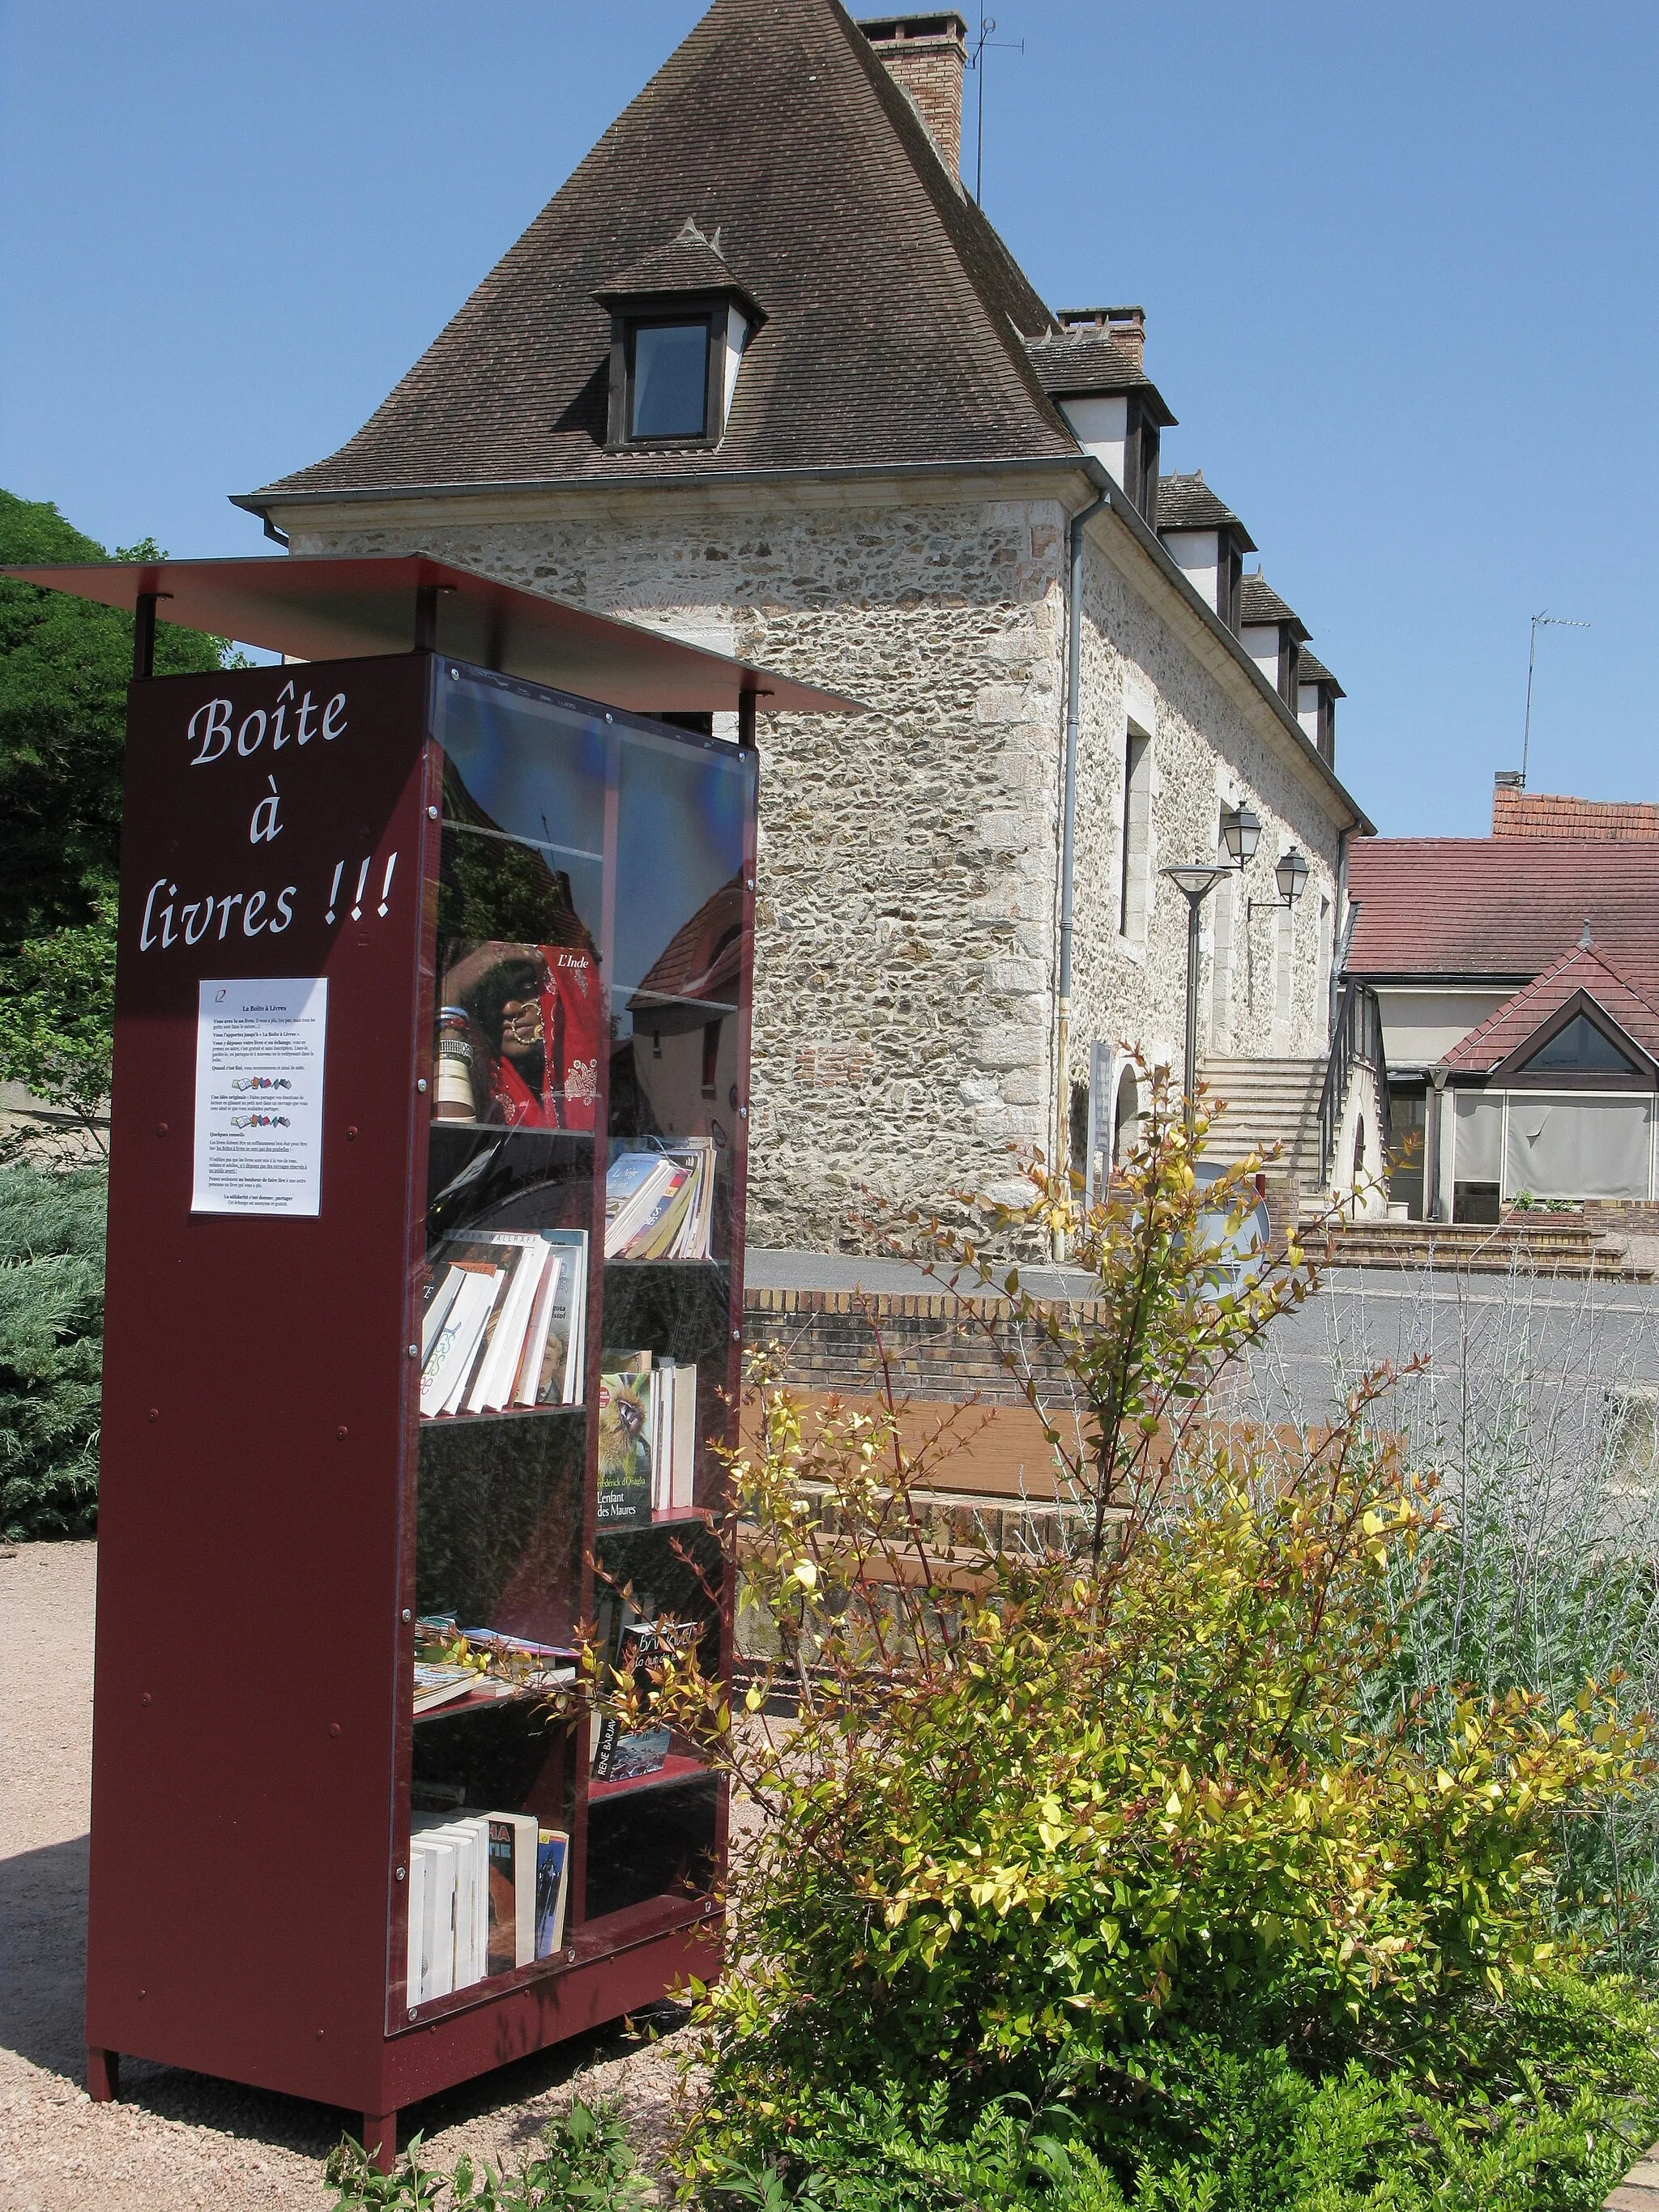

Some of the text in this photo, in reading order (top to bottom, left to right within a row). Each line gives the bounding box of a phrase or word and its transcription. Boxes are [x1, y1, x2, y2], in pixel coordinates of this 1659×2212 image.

[187, 680, 348, 766] Boîte
[249, 774, 284, 844] à
[139, 851, 398, 952] livres !!!
[557, 953, 589, 969] L'Inde
[596, 1490, 625, 1504] L'enfant
[597, 1503, 637, 1517] des Maures
